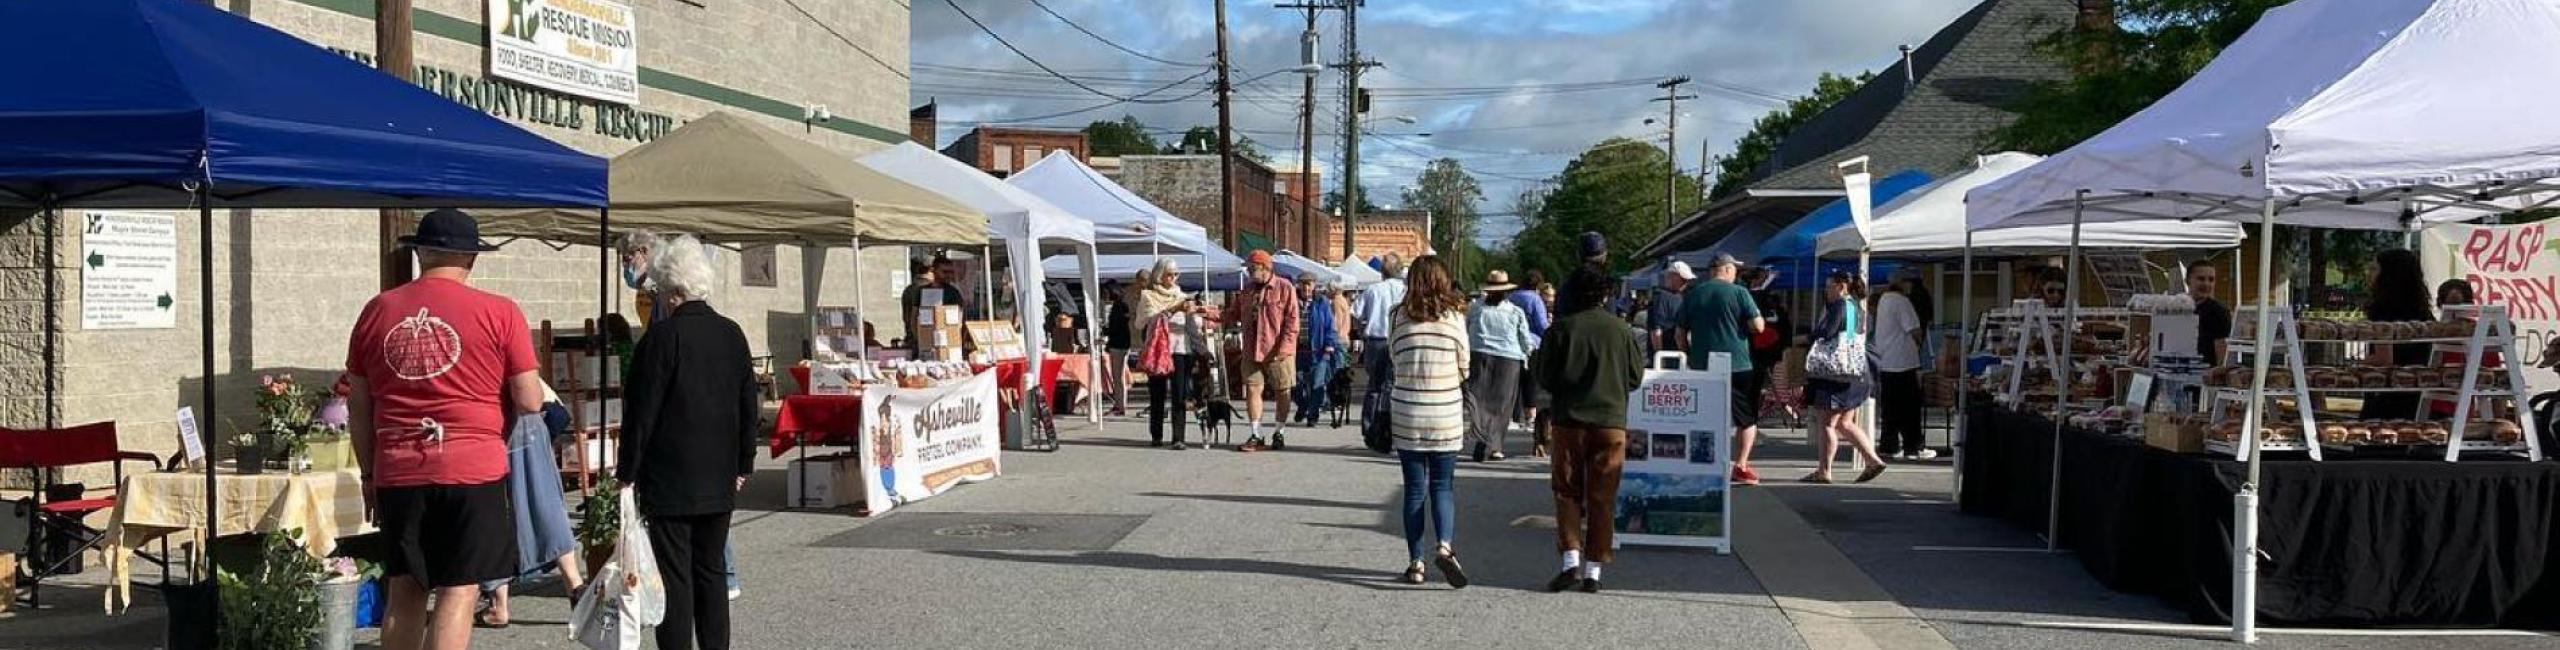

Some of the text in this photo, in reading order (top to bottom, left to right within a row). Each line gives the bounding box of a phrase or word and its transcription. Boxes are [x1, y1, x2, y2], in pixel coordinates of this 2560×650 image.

[542, 7, 590, 39] RESCUE
[2464, 223, 2545, 272] RASP
[1647, 394, 1692, 407] BERRY
[1652, 383, 1688, 395] RASP
[913, 394, 982, 444] Asheville
